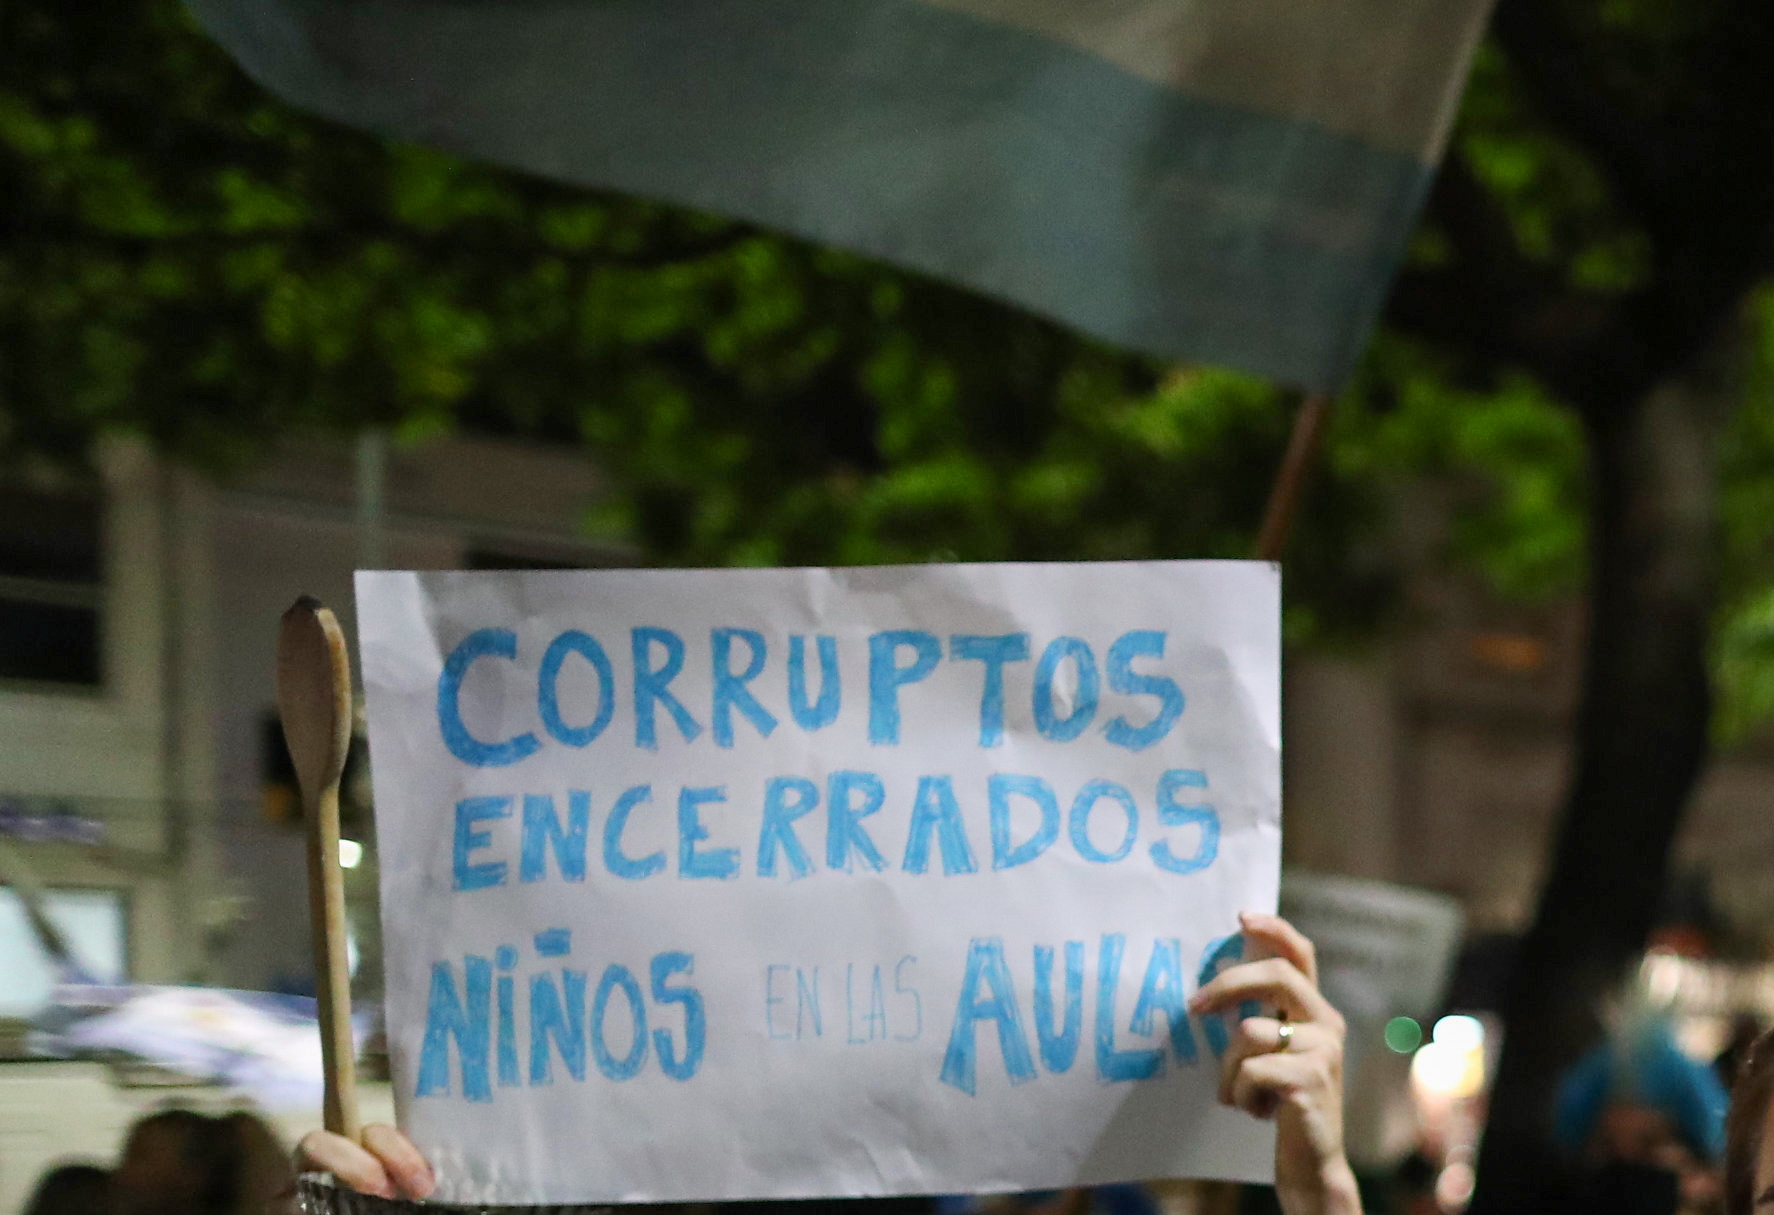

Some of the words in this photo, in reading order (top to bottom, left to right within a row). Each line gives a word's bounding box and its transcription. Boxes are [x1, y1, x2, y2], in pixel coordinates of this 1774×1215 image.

[436, 625, 1187, 768] CORRUPTOS
[452, 769, 1221, 892] ENCERRADOS
[766, 964, 823, 1041] EN
[846, 954, 922, 1045] LAS
